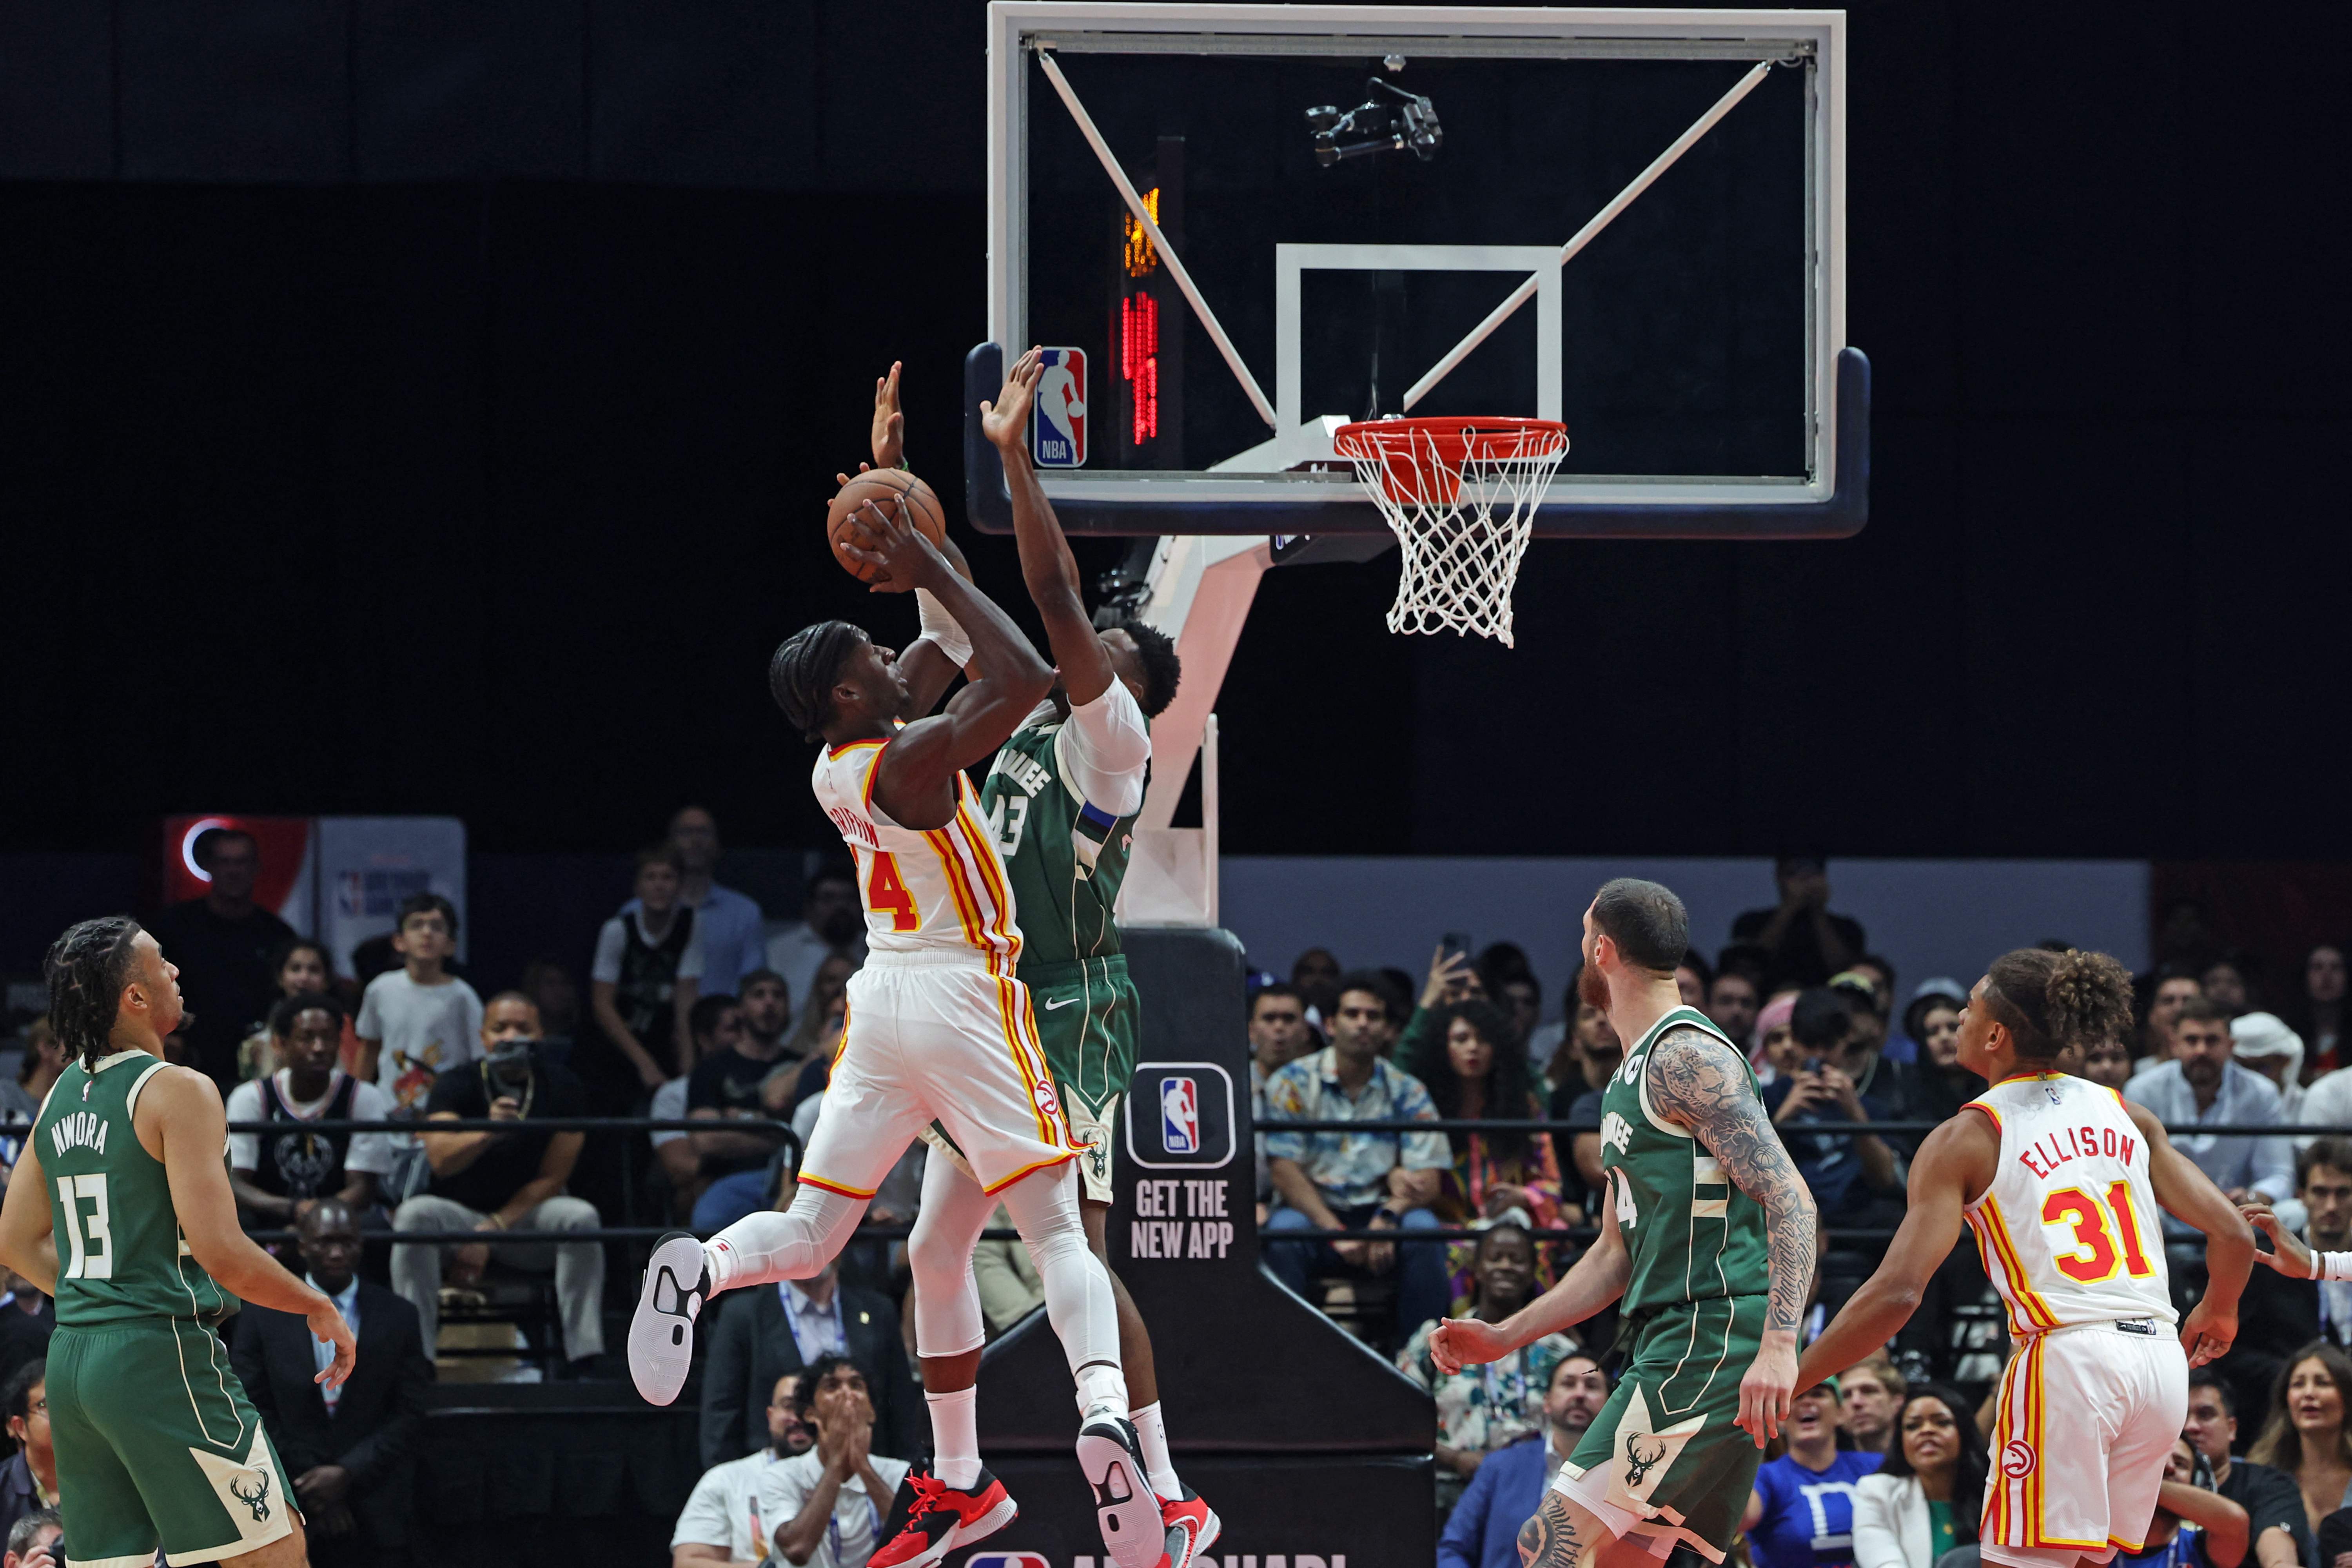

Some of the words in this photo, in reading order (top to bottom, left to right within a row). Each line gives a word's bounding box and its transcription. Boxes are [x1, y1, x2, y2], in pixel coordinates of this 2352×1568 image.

[1043, 440, 1066, 459] NBA
[829, 807, 879, 849] GRIFFIN
[850, 843, 922, 932] 4
[51, 1111, 109, 1158] NWORA
[1168, 1135, 1187, 1148] NBA
[2020, 1126, 2134, 1180] ELLISON
[1136, 1179, 1180, 1217] GET
[1183, 1180, 1229, 1217] THE
[1604, 1165, 1638, 1232] 4
[56, 1173, 113, 1279] 13
[1131, 1221, 1184, 1259] NEW
[1187, 1221, 1234, 1259] APP
[2041, 1180, 2156, 1285] 31
